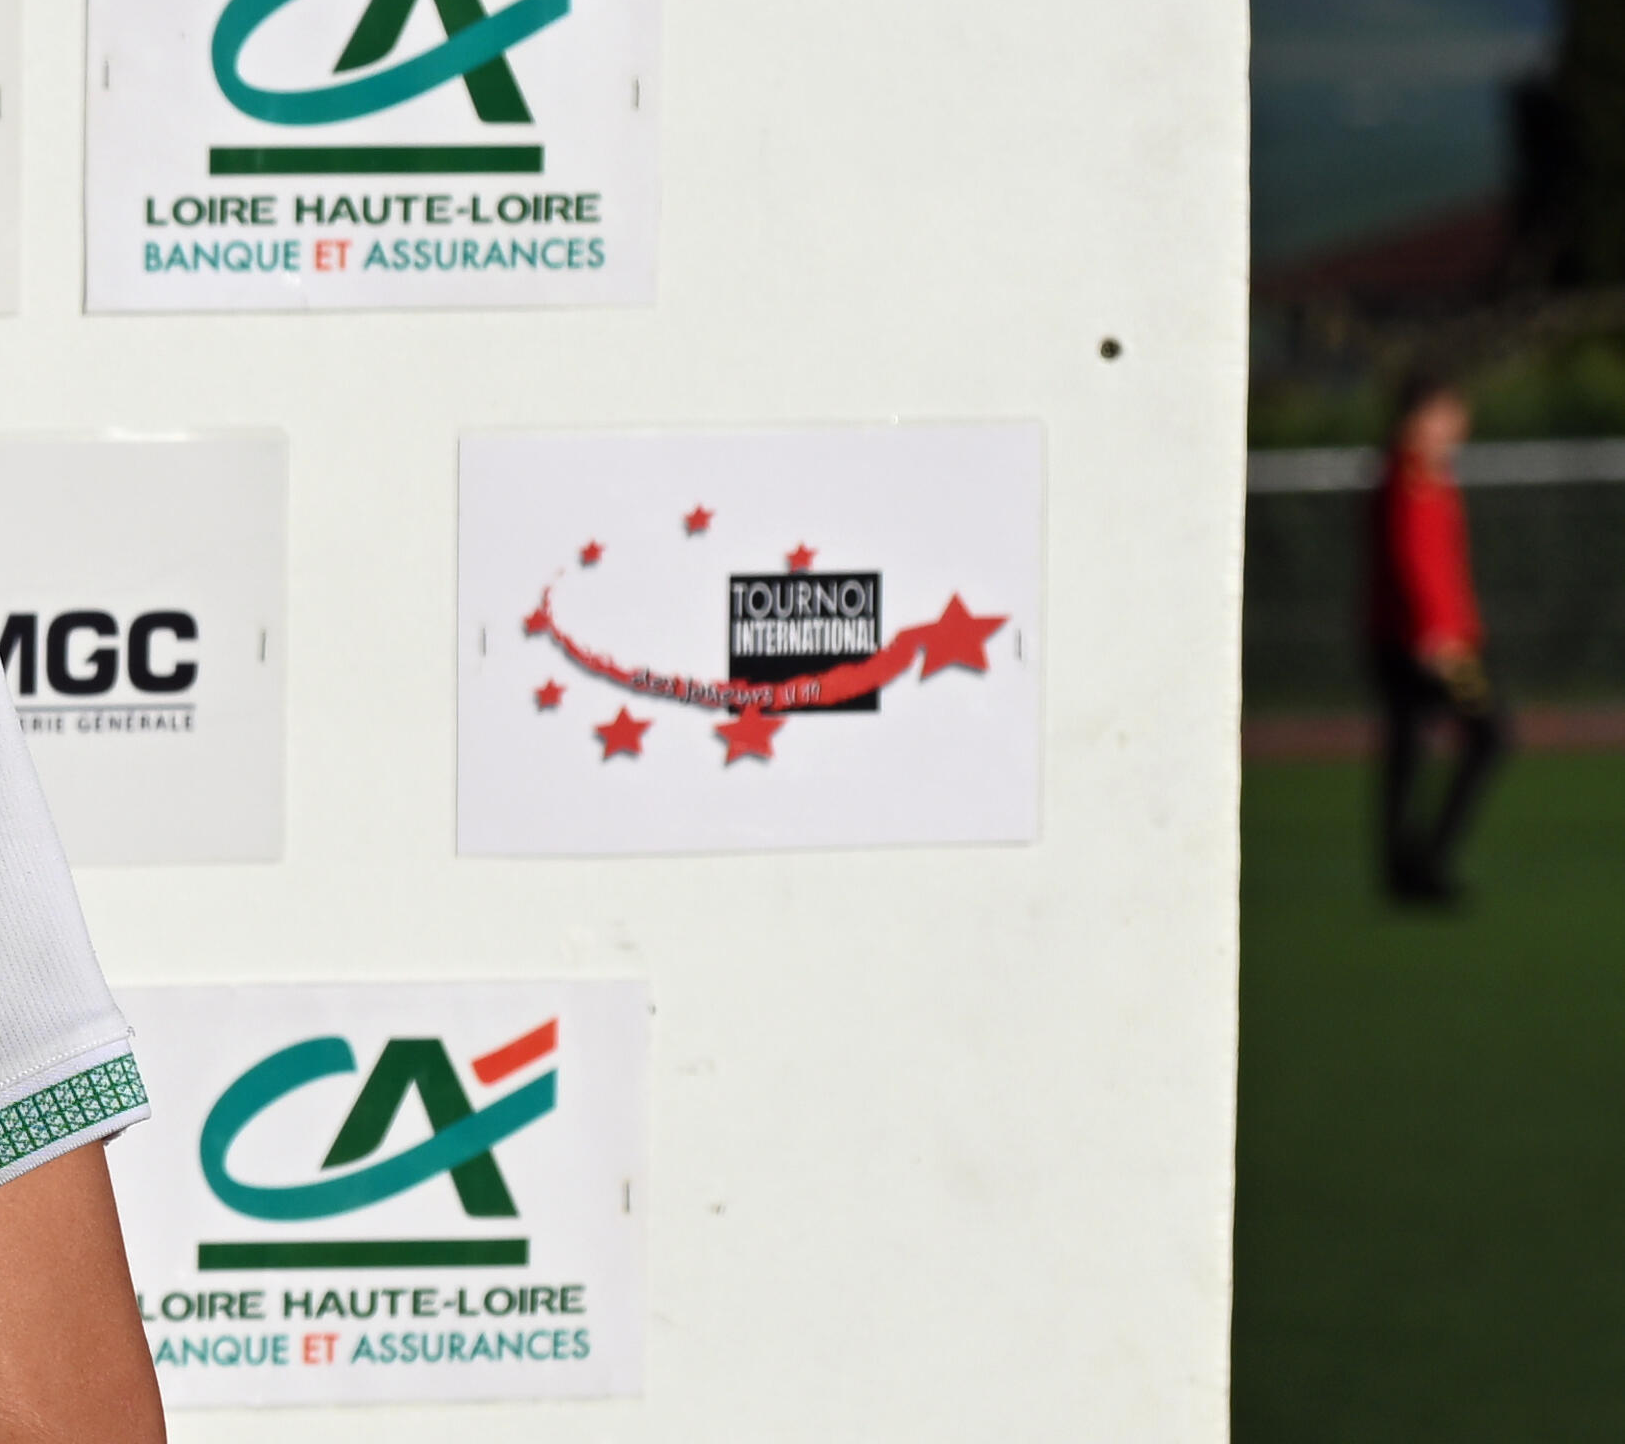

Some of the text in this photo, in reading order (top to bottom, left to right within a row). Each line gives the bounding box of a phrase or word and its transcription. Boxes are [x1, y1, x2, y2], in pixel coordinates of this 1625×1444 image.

[144, 193, 602, 227] LOIRE HAUTE-LOIRE
[143, 237, 606, 273] BANQUE ET ASSURANCES
[730, 579, 875, 618] TOURNOI
[283, 1284, 586, 1320] HAUTE-LOIRE
[154, 1329, 591, 1367] ANQUE ET ASSURANCES
